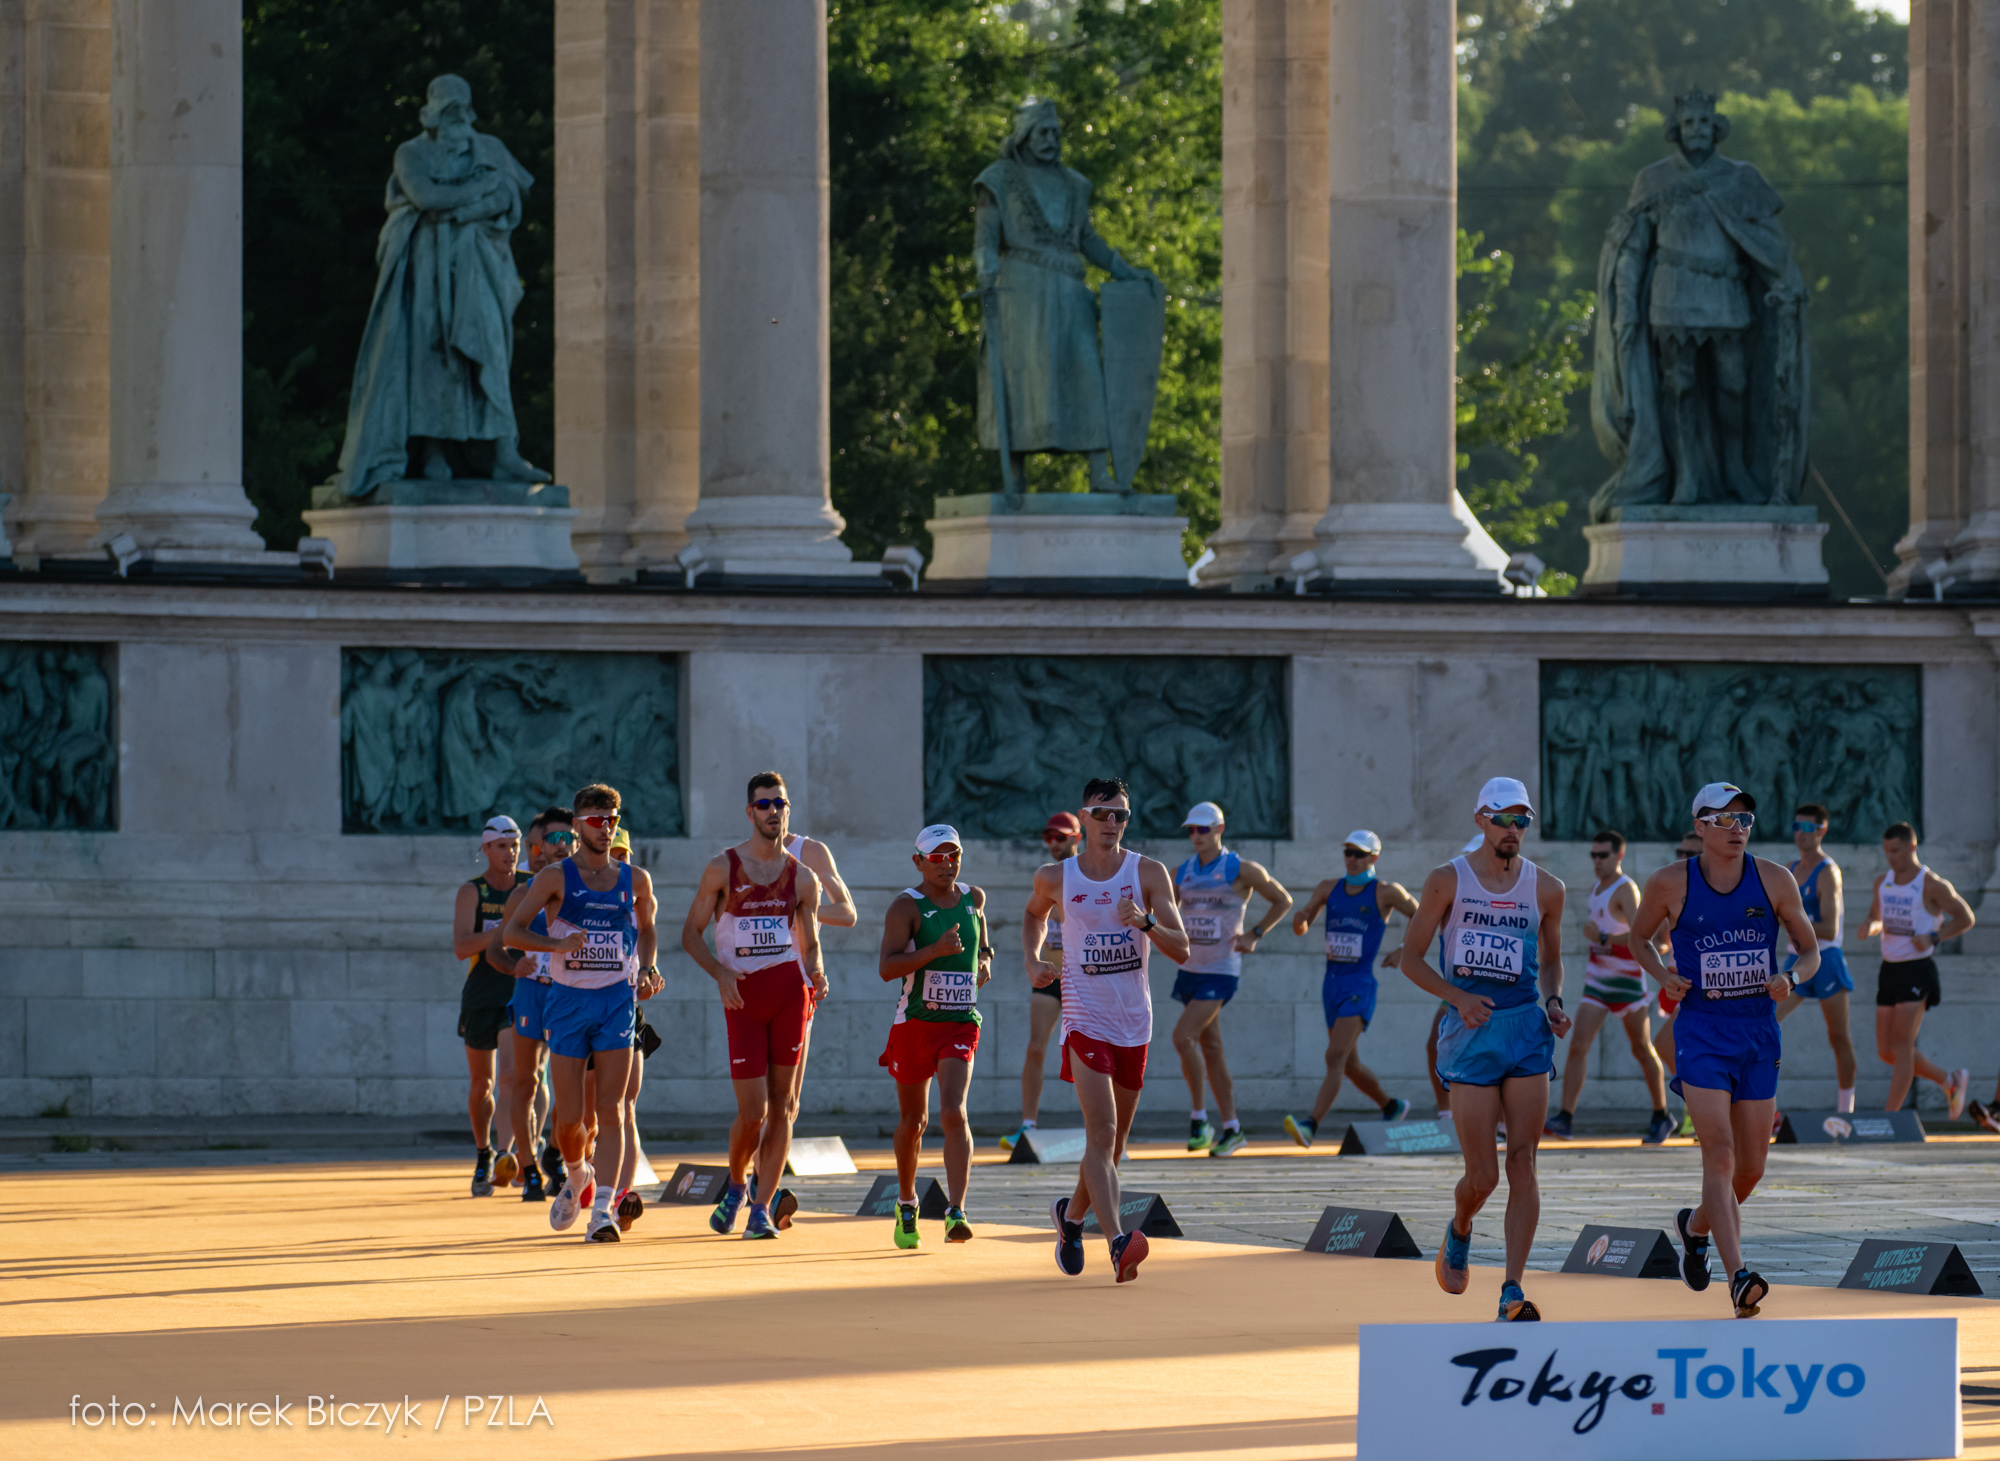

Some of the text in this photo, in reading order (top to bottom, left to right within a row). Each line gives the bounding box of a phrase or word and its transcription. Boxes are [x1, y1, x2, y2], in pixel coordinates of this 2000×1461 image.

[742, 899, 787, 909] ESPAÑA
[1462, 898, 1483, 906] CRAFT
[582, 919, 611, 927] ITALIA
[750, 918, 783, 929] TDK
[1190, 917, 1216, 926] TDK
[1463, 911, 1529, 929] FINLAND
[587, 933, 617, 944] TDK
[752, 932, 776, 945] TUR
[1096, 929, 1134, 946] TDK
[1334, 935, 1358, 945] TDK
[1476, 932, 1518, 954] TDK
[571, 947, 617, 959] ORSONI
[1083, 945, 1137, 962] TOMALA
[1720, 951, 1765, 967] TDK
[1465, 950, 1512, 971] OJALA
[1100, 963, 1132, 972] BUDAPEST
[942, 974, 973, 985] TDK
[1473, 970, 1509, 980] BUDAPEST
[1705, 969, 1766, 987] MONTANA
[929, 988, 971, 1001] LEYVER
[1724, 988, 1758, 997] BUDAPEST
[1330, 1212, 1358, 1234] LÁSS
[1325, 1228, 1366, 1252] CSODÁT!
[1874, 1246, 1928, 1268] WITNESS
[1860, 1266, 1922, 1289] THE WONDER
[1450, 1347, 1866, 1434] Tokyo Tokyo
